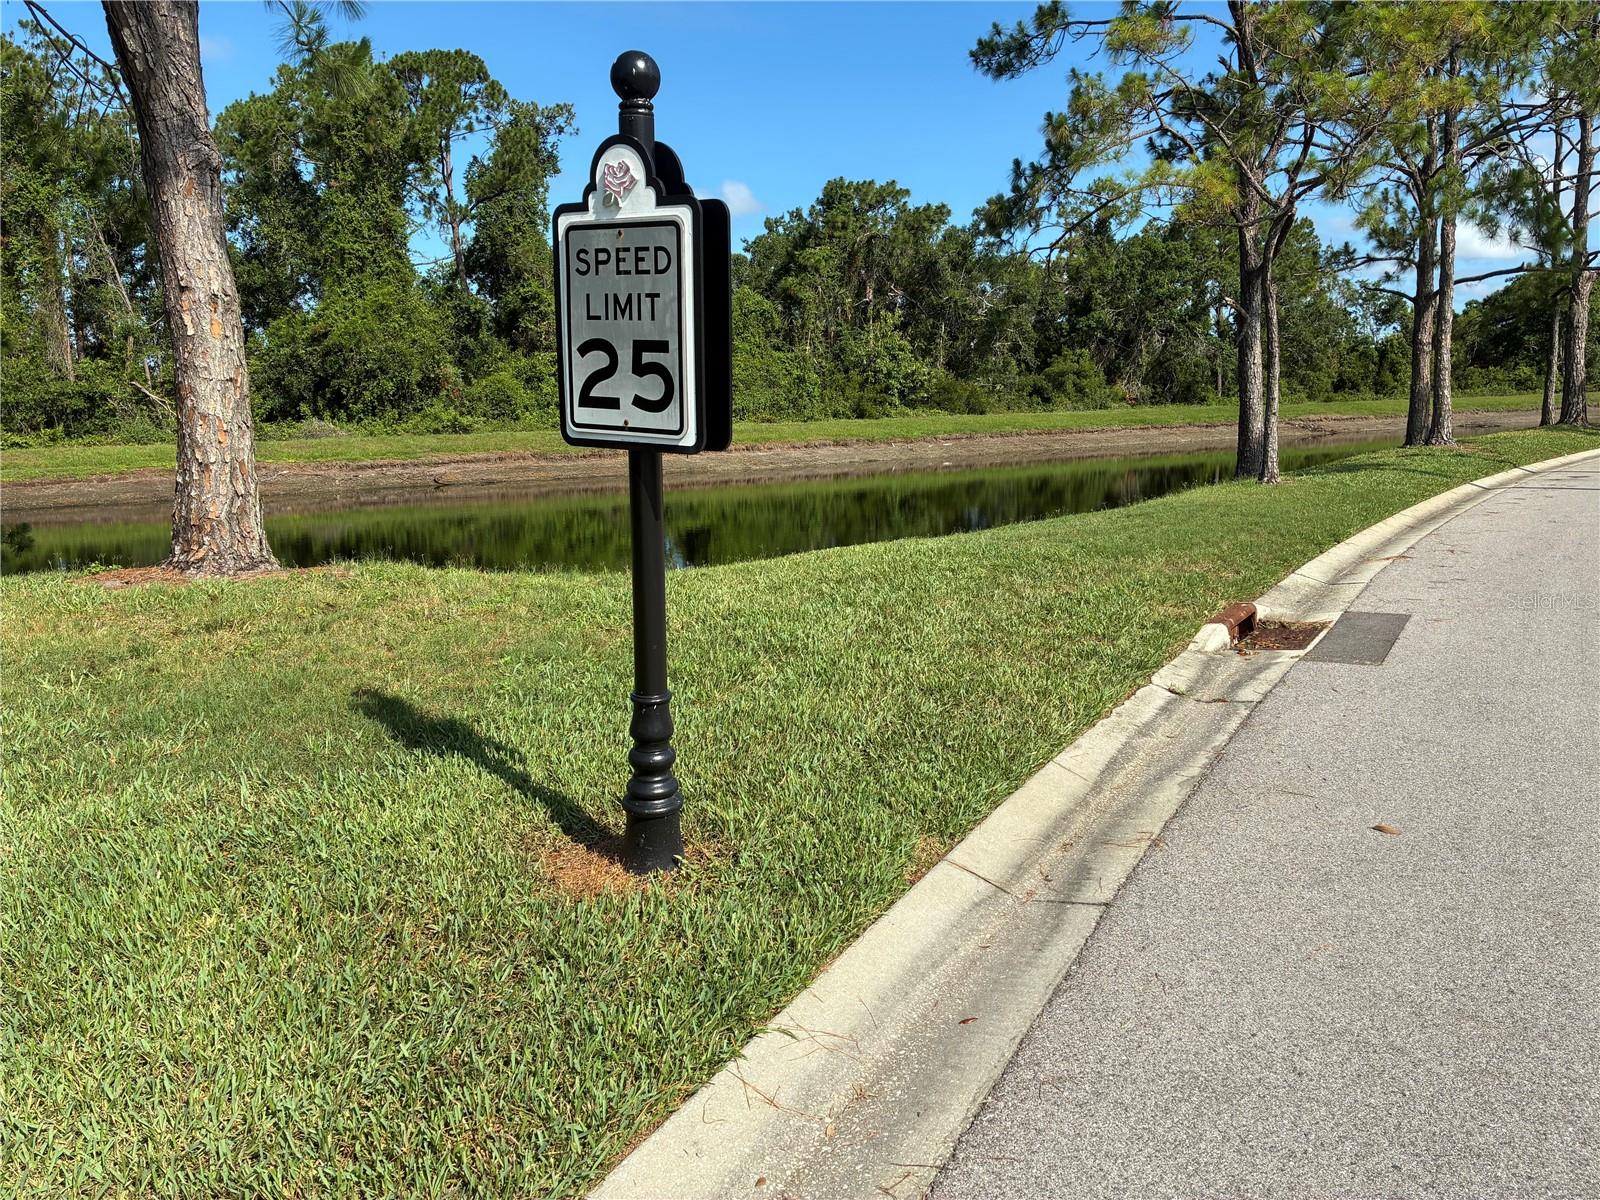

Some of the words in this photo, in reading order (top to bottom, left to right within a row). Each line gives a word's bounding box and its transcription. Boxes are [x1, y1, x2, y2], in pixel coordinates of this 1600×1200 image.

[575, 246, 672, 276] SPEED
[586, 293, 661, 321] LIMIT
[576, 338, 675, 413] 25
